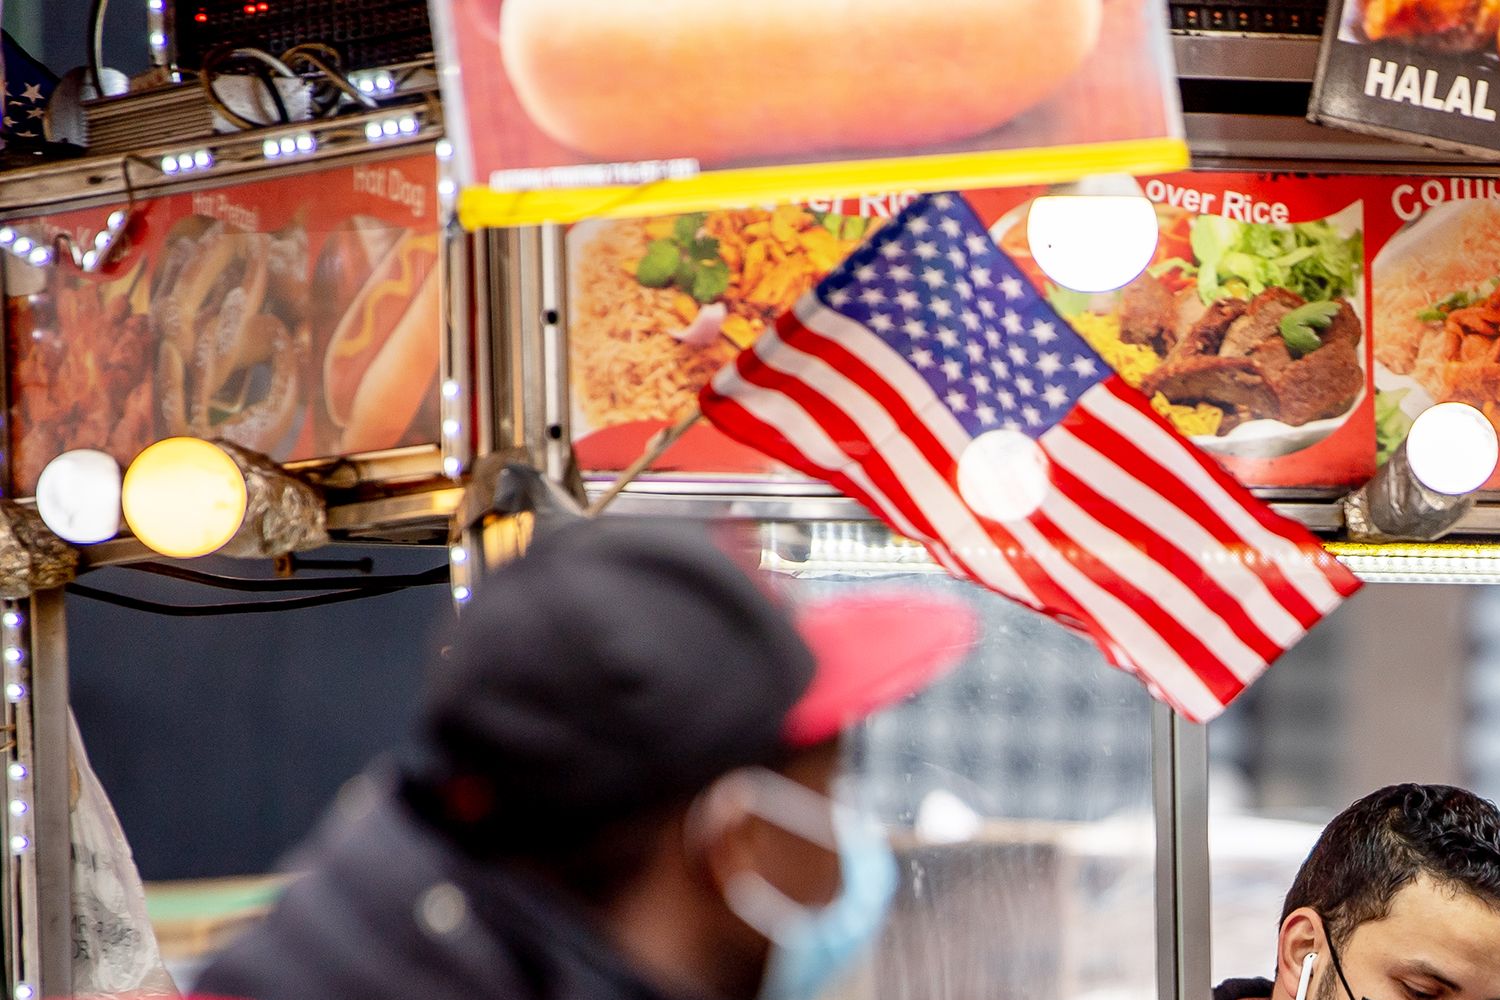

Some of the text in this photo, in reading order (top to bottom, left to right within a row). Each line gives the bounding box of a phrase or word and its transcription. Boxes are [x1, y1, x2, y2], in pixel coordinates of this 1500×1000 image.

[1364, 58, 1496, 122] HALAL
[1145, 180, 1290, 224] over Rice
